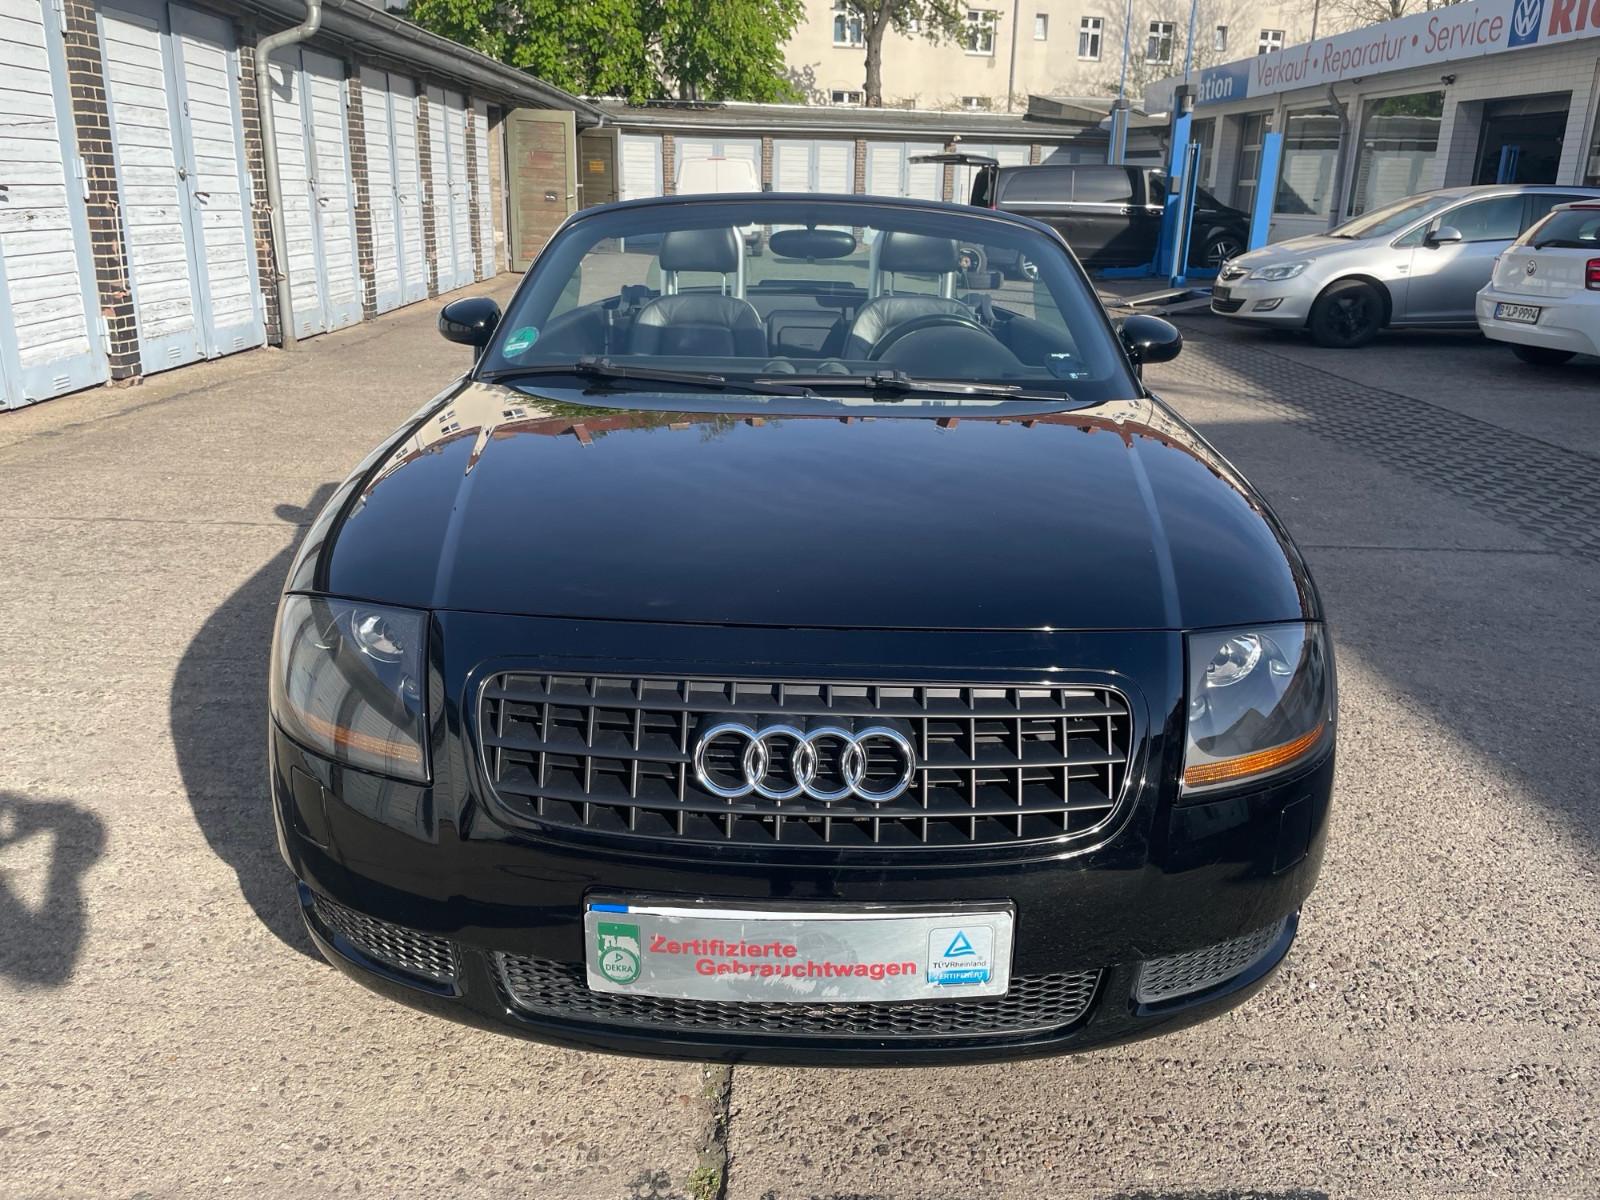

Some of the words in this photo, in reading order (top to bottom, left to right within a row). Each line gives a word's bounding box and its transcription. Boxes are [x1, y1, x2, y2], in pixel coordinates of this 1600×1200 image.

[1257, 45, 1312, 87] Verkauf
[1322, 32, 1407, 78] Reparatur
[1425, 7, 1504, 54] Service
[1198, 72, 1233, 101] ation
[650, 936, 798, 958] Zertifizierte
[605, 963, 634, 973] DEKRA
[695, 958, 918, 981] Gebrauchtwagen
